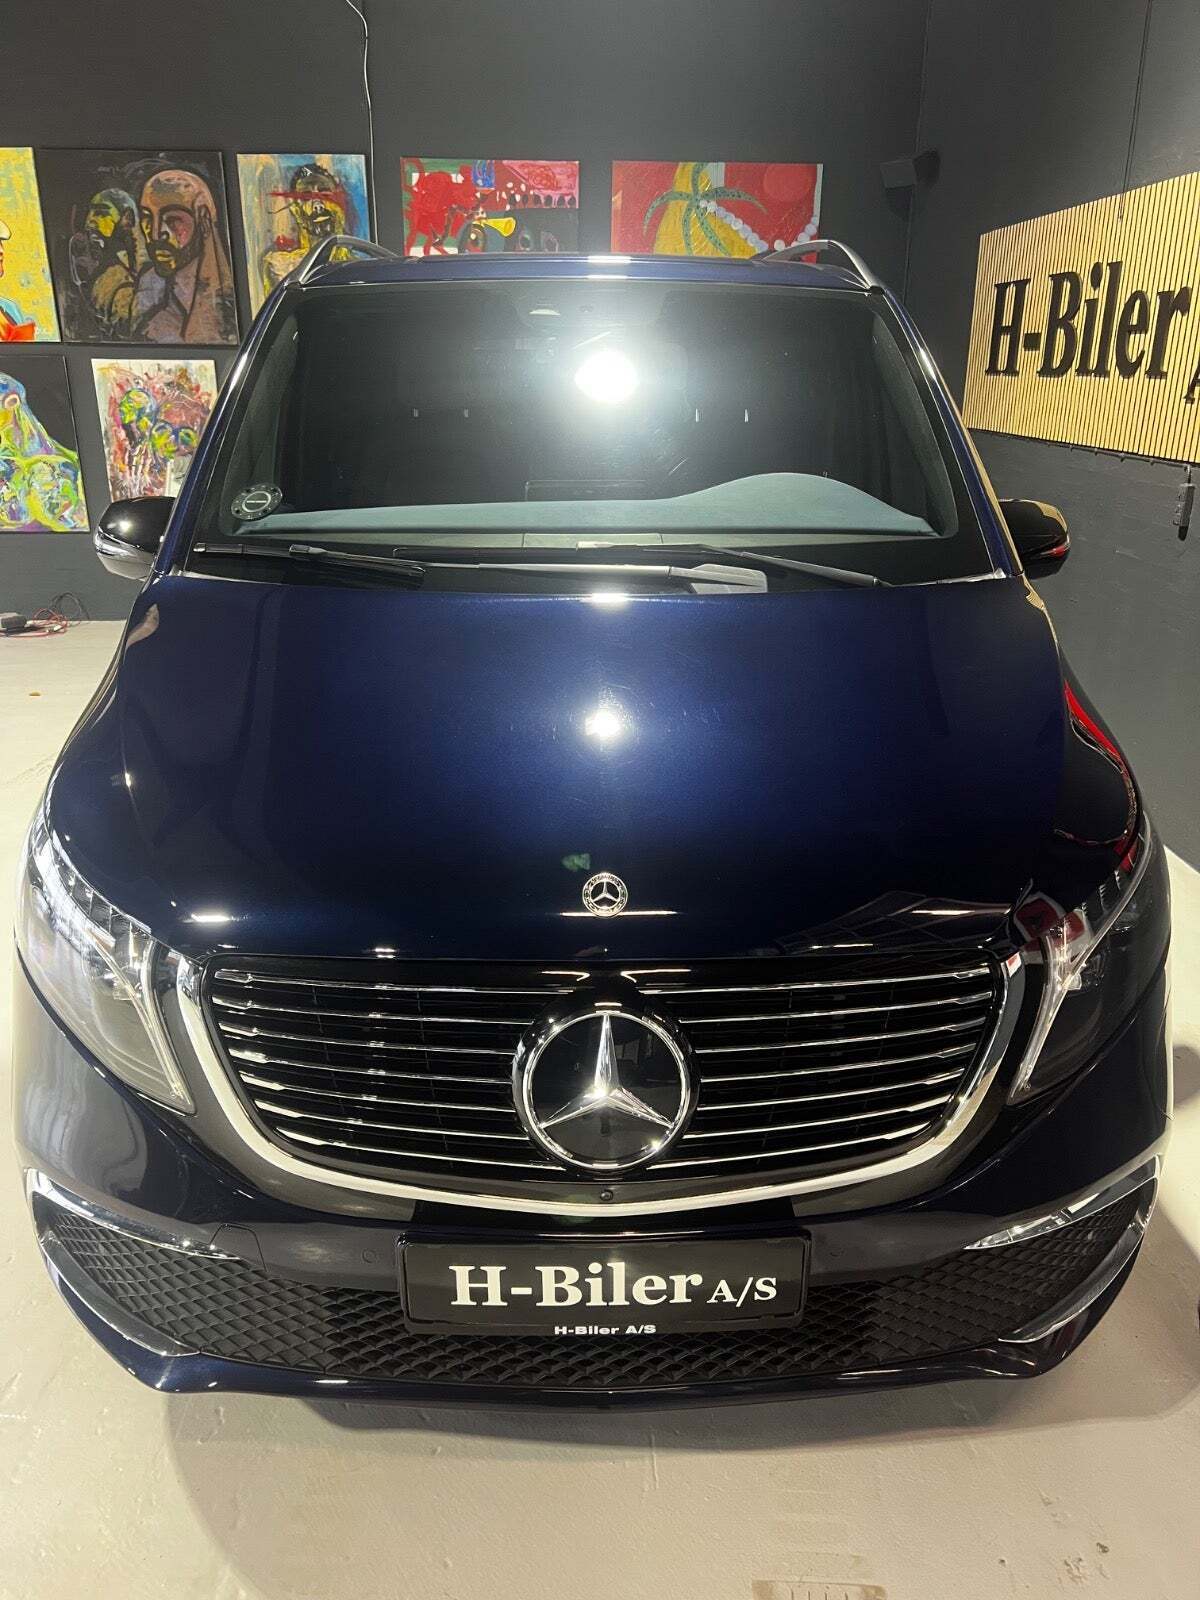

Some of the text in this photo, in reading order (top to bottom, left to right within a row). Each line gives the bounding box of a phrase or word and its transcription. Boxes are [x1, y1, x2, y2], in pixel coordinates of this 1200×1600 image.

[985, 260, 1193, 379] H-Biler
[449, 1262, 778, 1307] H-Biler A/S
[554, 1324, 657, 1335] H-Biler A/S
